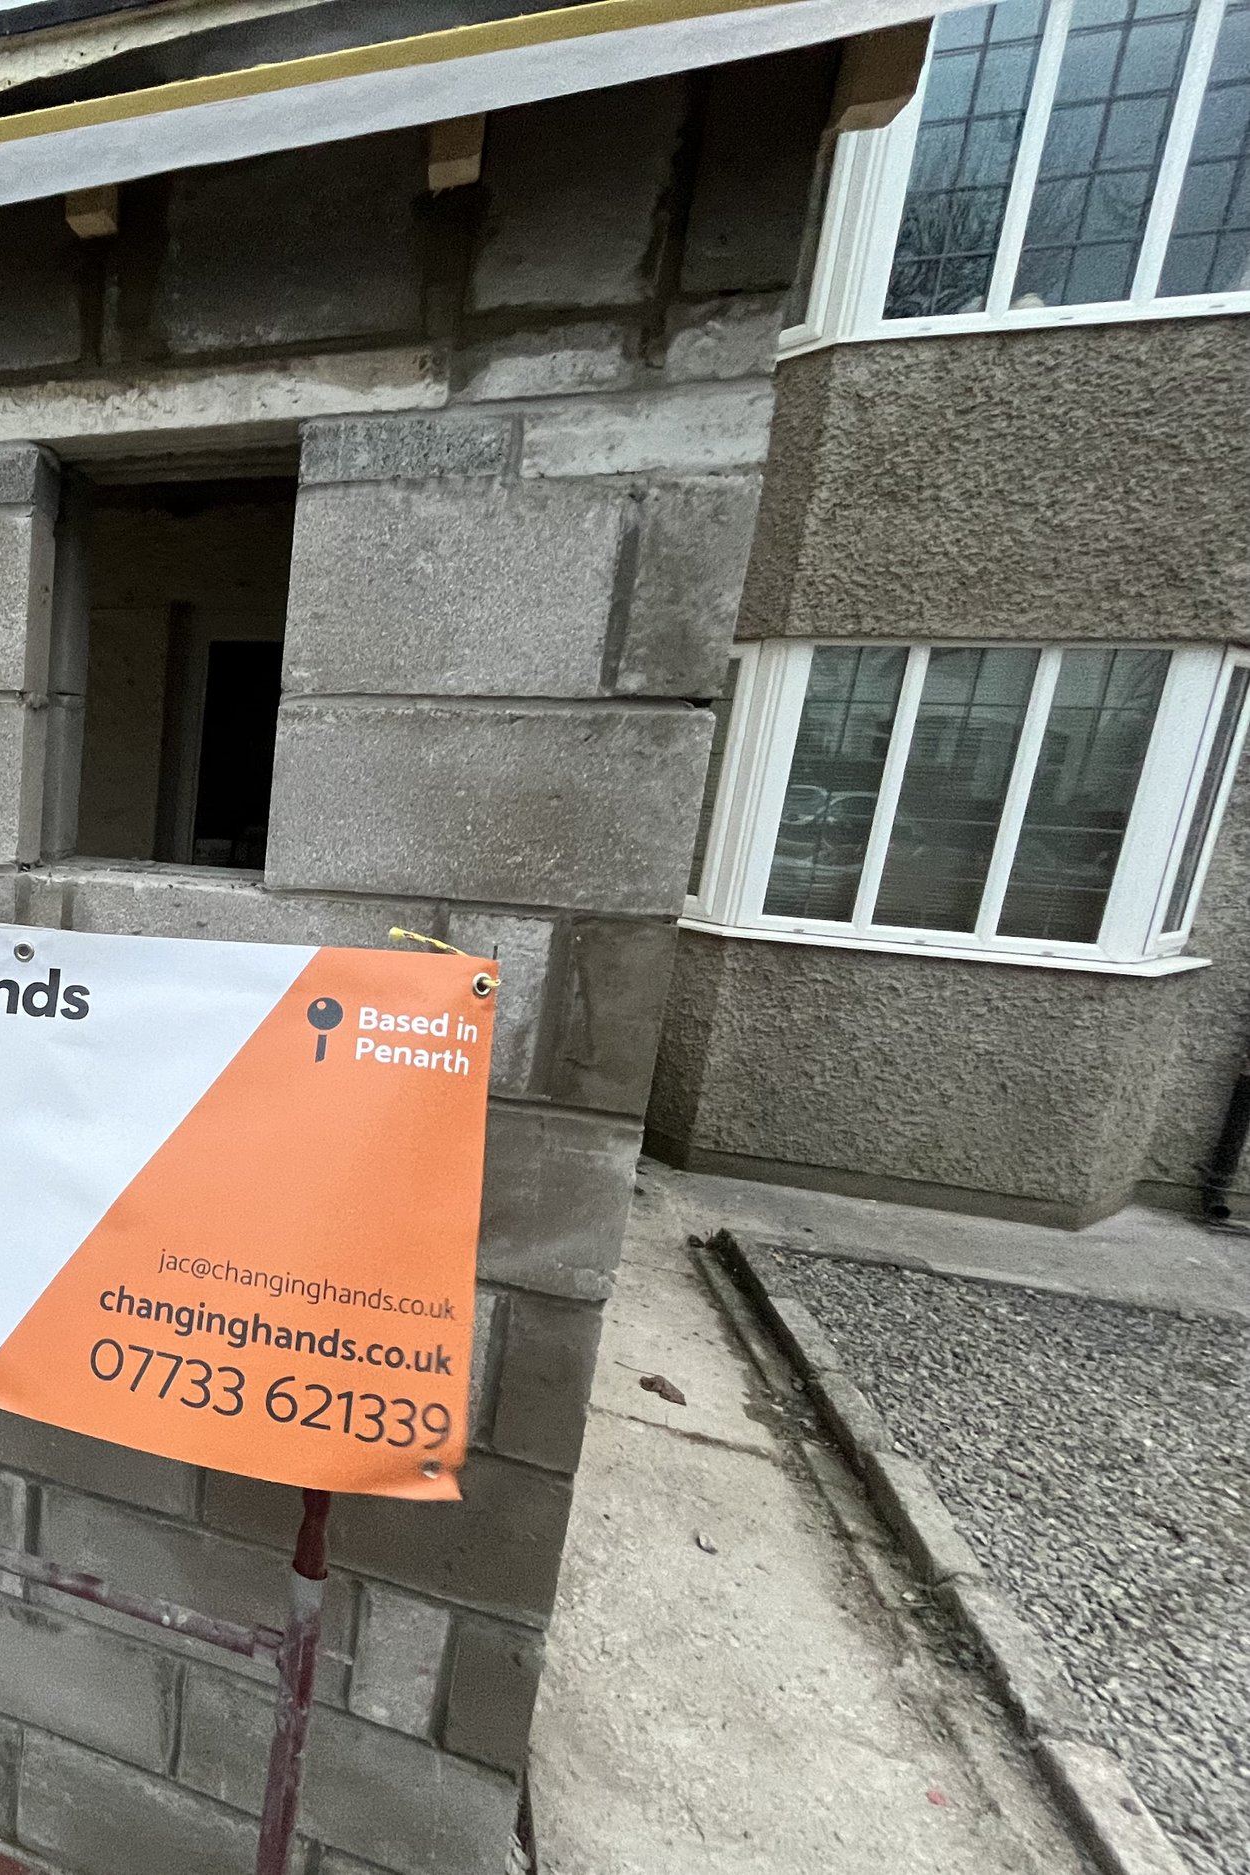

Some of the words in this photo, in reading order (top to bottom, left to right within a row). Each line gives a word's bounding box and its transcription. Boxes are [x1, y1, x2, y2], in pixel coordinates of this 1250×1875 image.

[354, 1037, 470, 1076] Penarth
[358, 1006, 449, 1038] Based
[456, 1015, 478, 1044] in
[157, 1249, 456, 1320] jac@changinghands.co.uk
[99, 1286, 453, 1376] changinghands.co.uk
[90, 1338, 245, 1416] 07733
[265, 1375, 451, 1449] 621339
